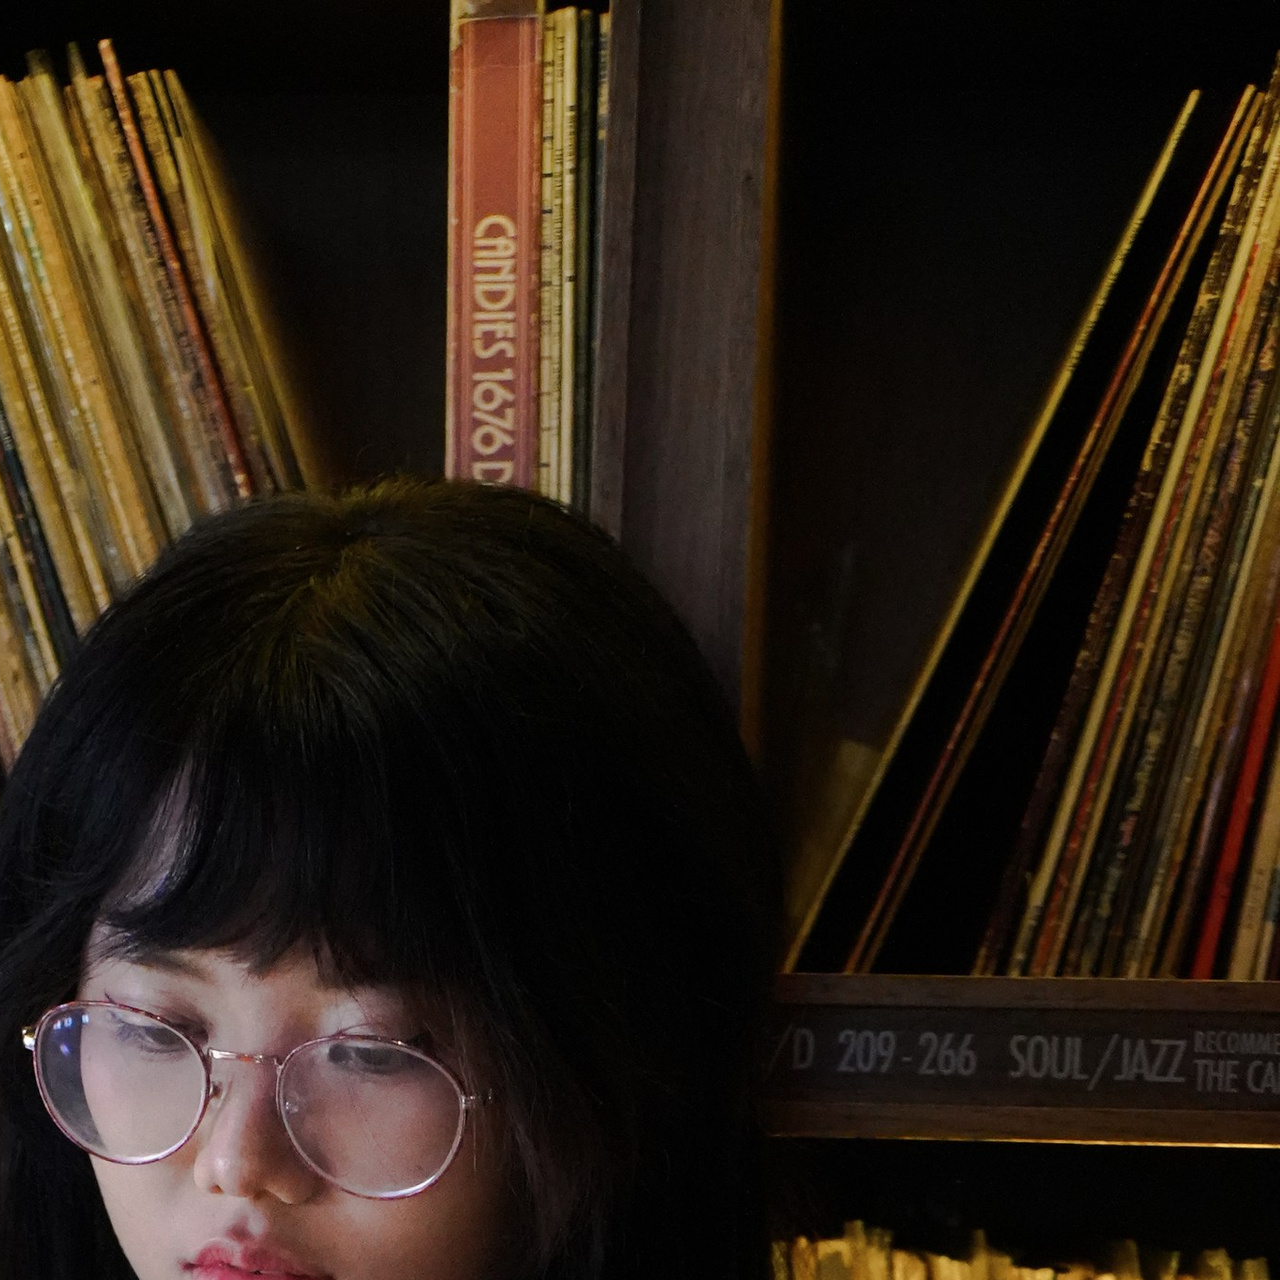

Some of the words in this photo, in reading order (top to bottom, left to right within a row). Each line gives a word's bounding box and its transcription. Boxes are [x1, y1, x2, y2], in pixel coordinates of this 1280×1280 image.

[473, 213, 517, 360] CANDIES
[472, 368, 516, 457] 1676
[1008, 1033, 1187, 1091] SOUL/JAZZ
[1193, 1058, 1240, 1094] THE
